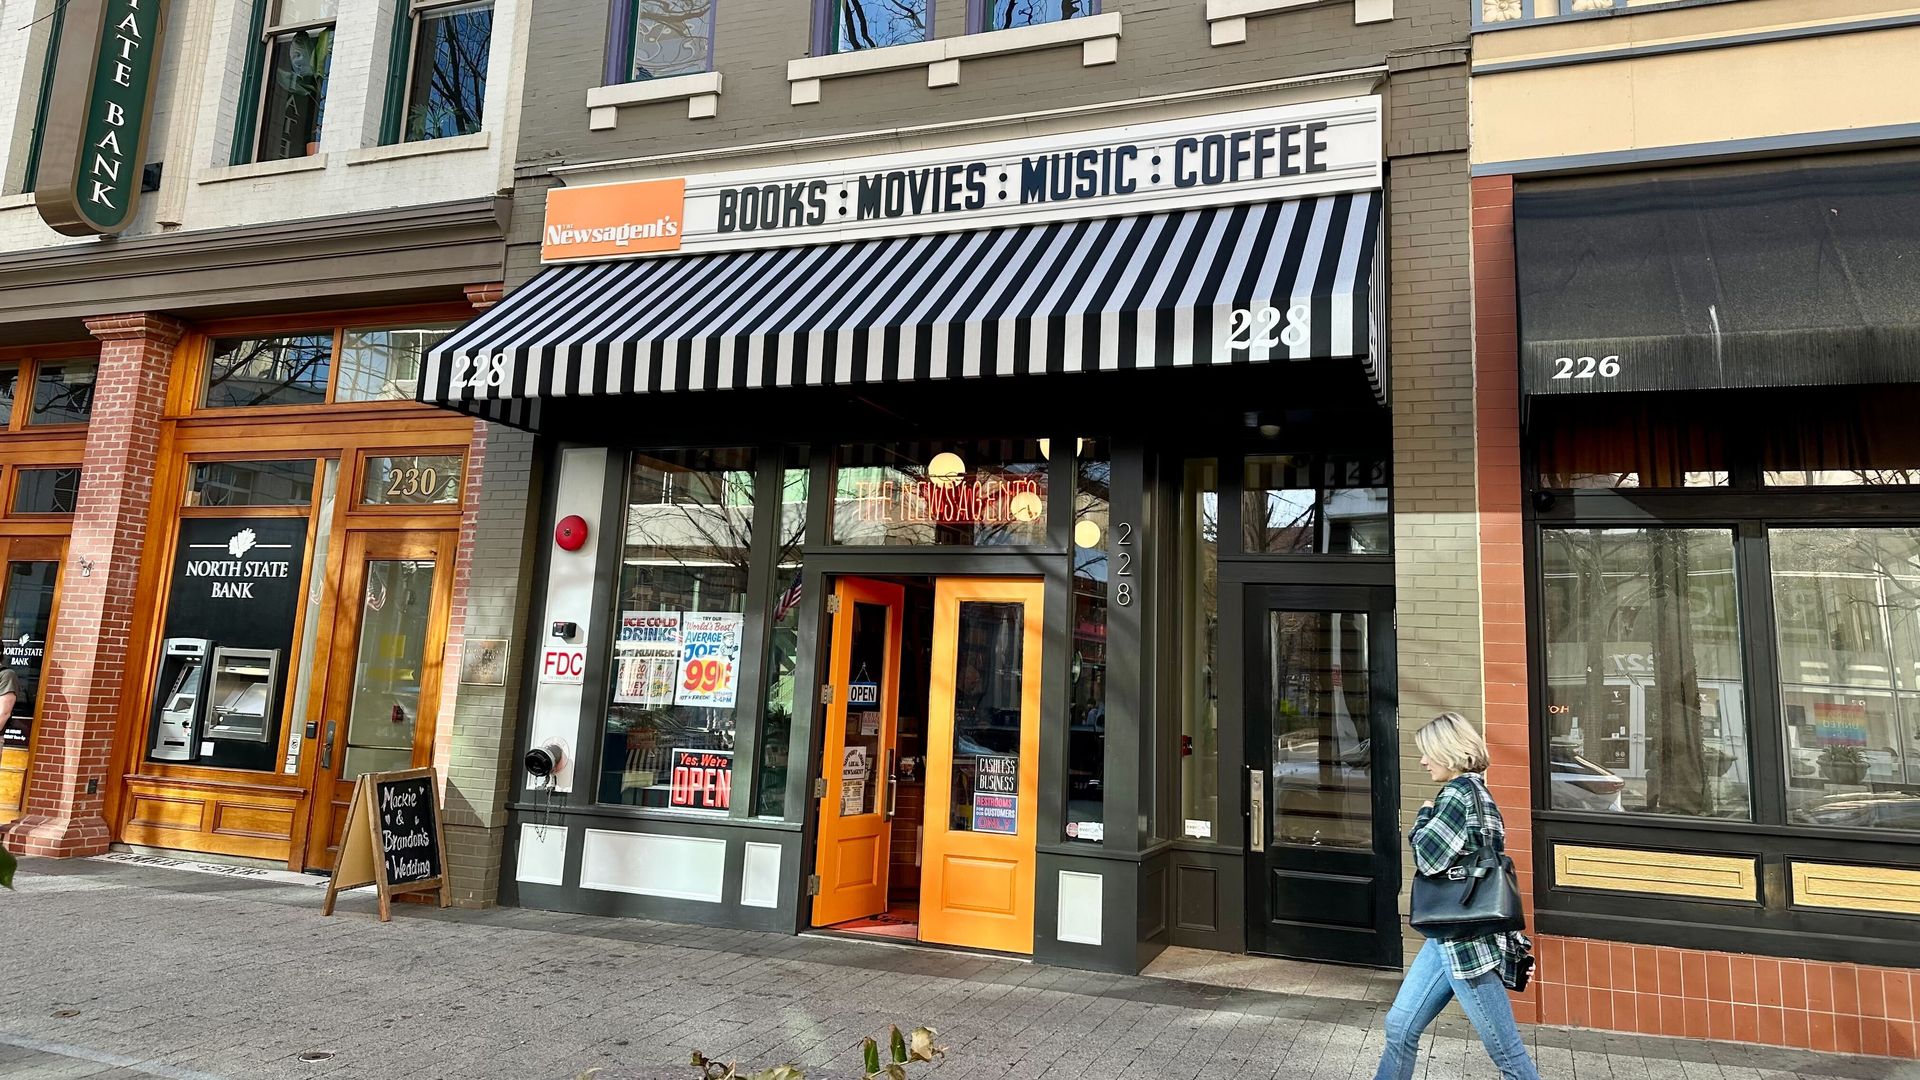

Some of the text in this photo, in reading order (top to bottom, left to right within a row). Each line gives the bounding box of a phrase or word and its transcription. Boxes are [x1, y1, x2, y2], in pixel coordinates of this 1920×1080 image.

[90, 100, 124, 209] BANK
[717, 180, 827, 233] BOOKS
[857, 162, 987, 221] MOVIES
[1020, 145, 1138, 204] MUSIC
[1174, 121, 1328, 188] COFFEE
[546, 215, 678, 247] Newsagent's
[1223, 304, 1309, 350] 228
[450, 352, 508, 388] 228
[1551, 355, 1621, 379] 226
[386, 467, 437, 496] 230
[855, 480, 893, 521] THE
[185, 560, 289, 577] NORTH STATE
[1116, 522, 1132, 606] 228
[211, 581, 254, 598] BANK
[623, 617, 678, 627] ICE COLD
[622, 627, 678, 641] DRINKS
[686, 631, 722, 643] AVERAGE
[24, 647, 43, 657] STATE
[684, 643, 720, 662] JOE
[11, 657, 29, 666] BANK
[544, 651, 583, 676] FDC
[850, 686, 875, 702] OPEN
[680, 753, 728, 768] Yes, We're
[979, 757, 1016, 774] CASHLESS
[672, 766, 732, 808] OPEN
[979, 774, 1014, 792] BUSINESS
[381, 786, 417, 812] Mackie
[976, 797, 1012, 808] RESTROOMS
[395, 809, 404, 825] &
[984, 808, 1015, 819] CUSTOMERS
[977, 817, 1012, 831] ONLY
[383, 827, 430, 852] Brandon's
[391, 855, 430, 880] Wedding
